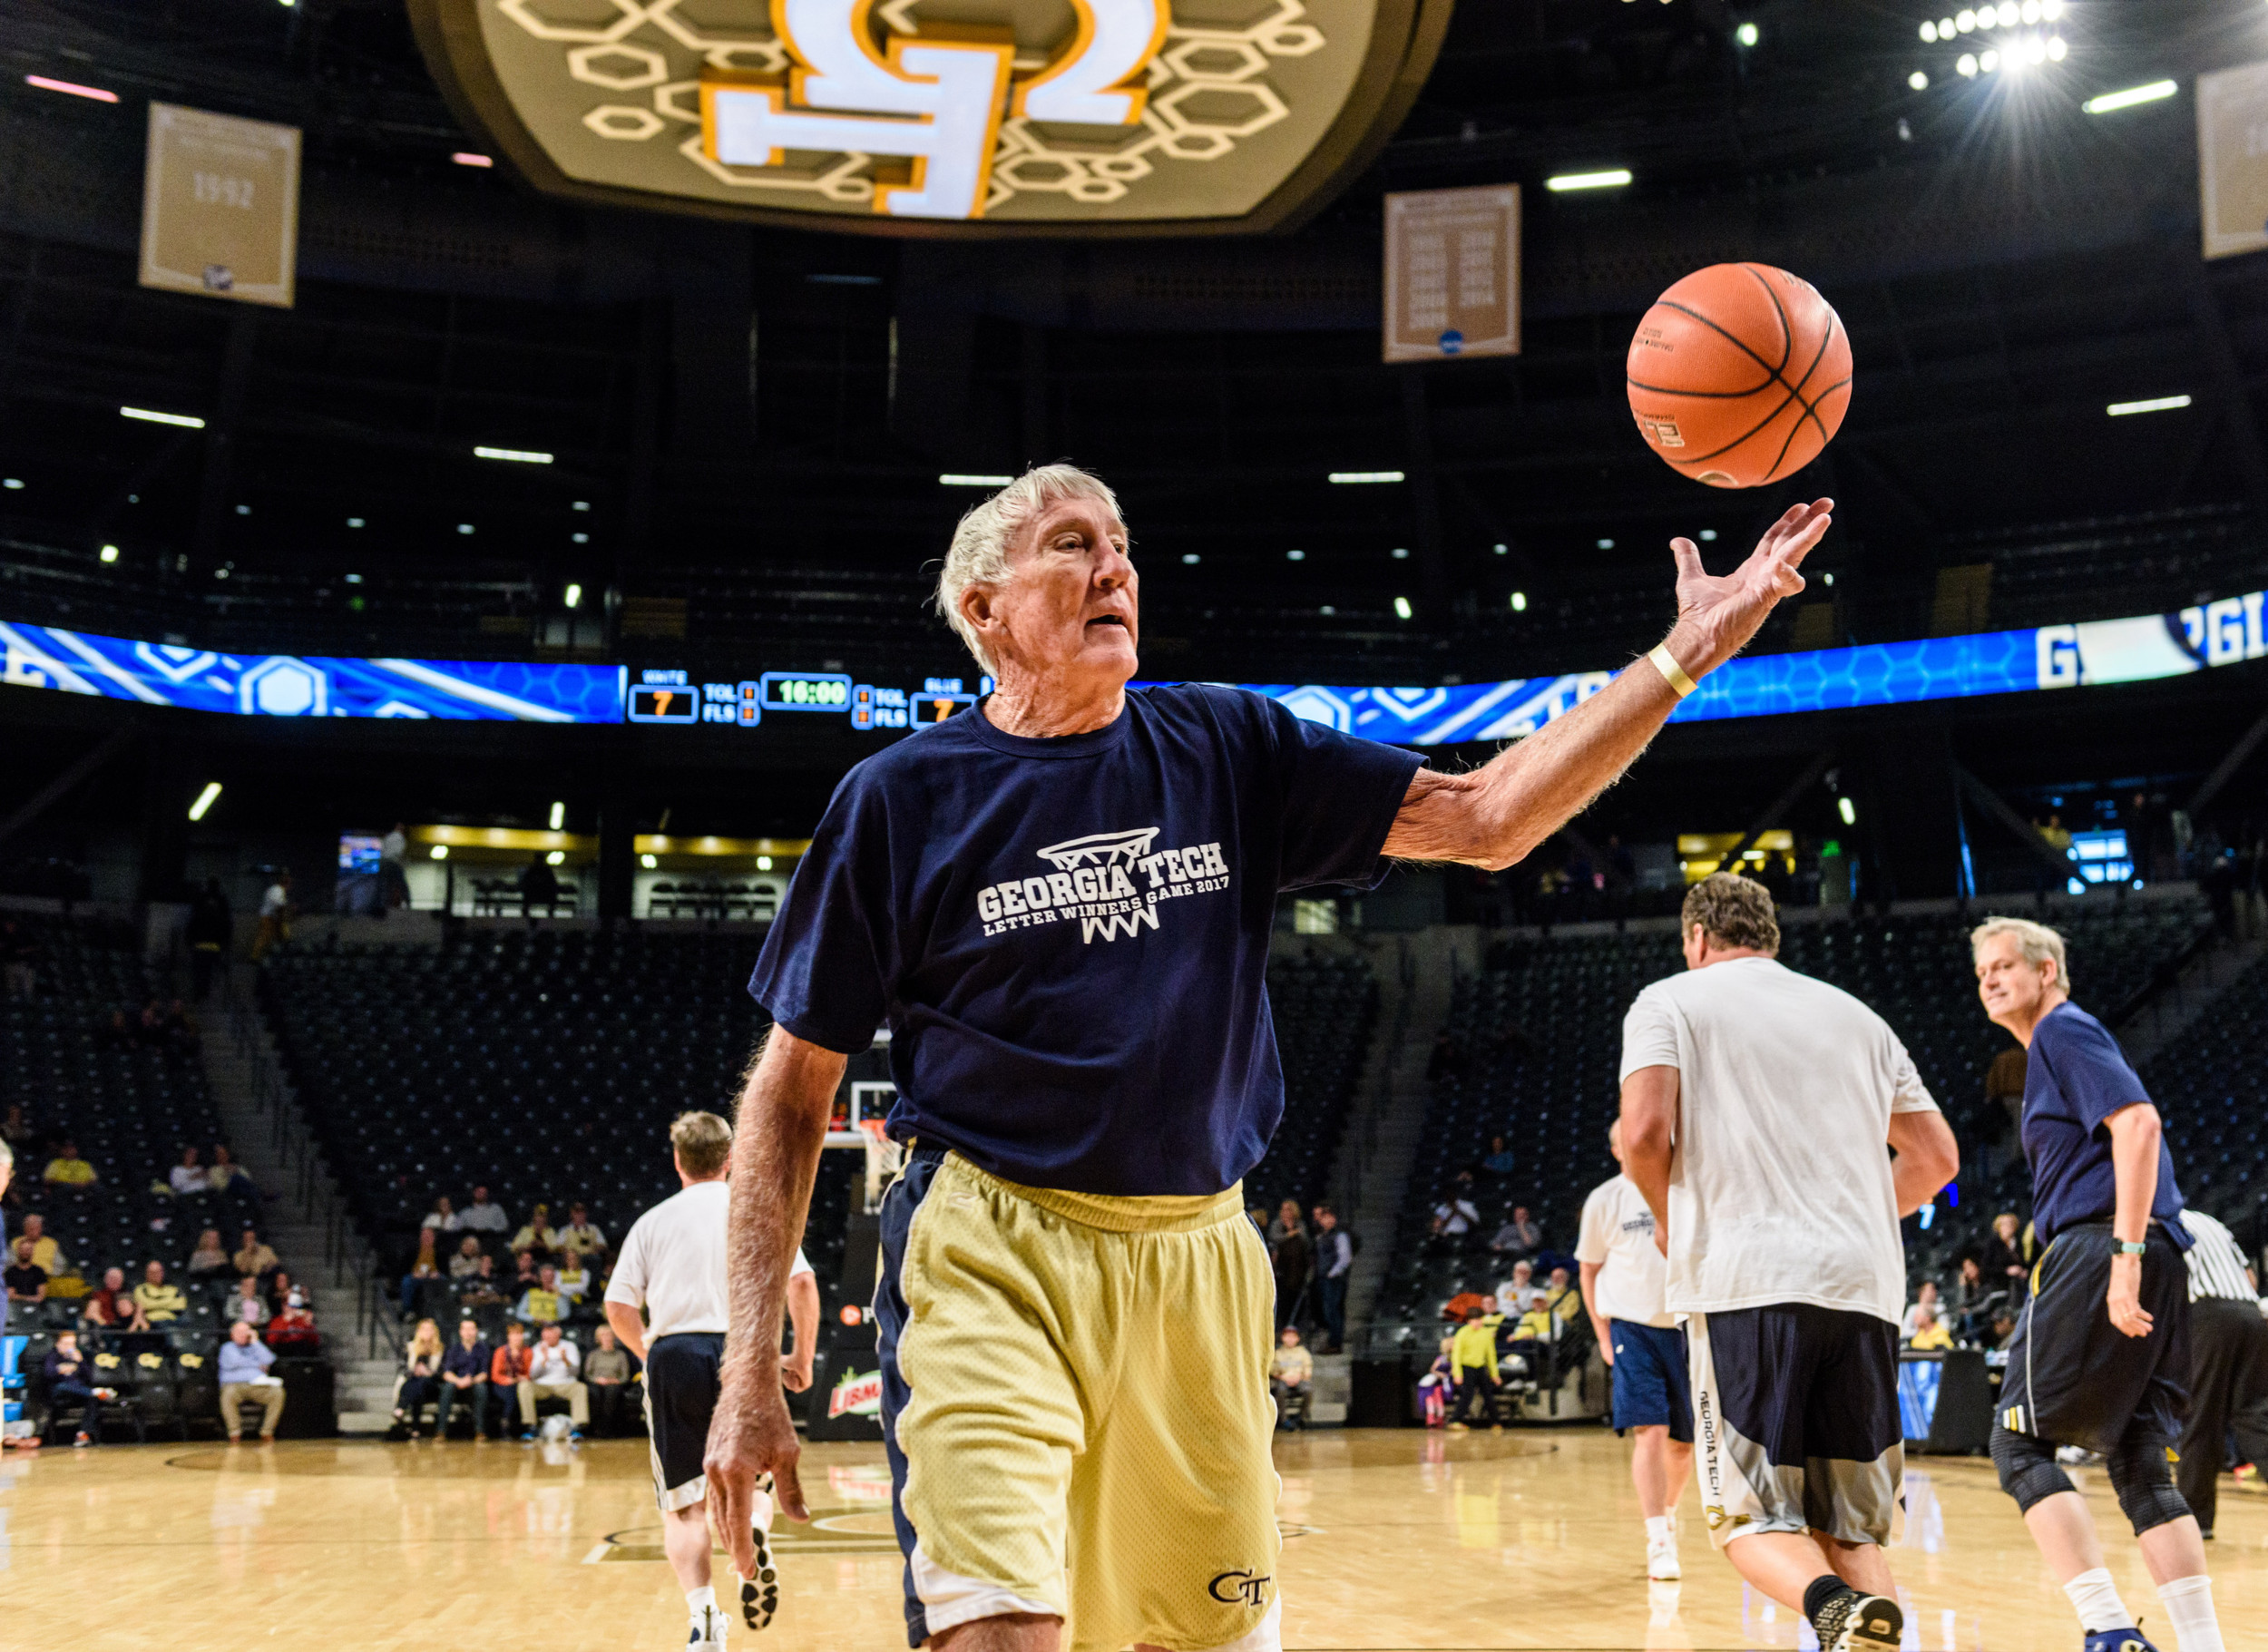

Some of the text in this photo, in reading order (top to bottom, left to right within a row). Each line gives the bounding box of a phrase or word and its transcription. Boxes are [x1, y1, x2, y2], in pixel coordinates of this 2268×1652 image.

[652, 690, 673, 717] 7
[779, 679, 846, 704] 16:00
[977, 842, 1229, 923] GEORGIA TECH
[982, 875, 1230, 937] LETTER WINNERS GAME 2017
[1700, 1391, 1716, 1454] GEORGIA
[1706, 1455, 1720, 1496] TECH
